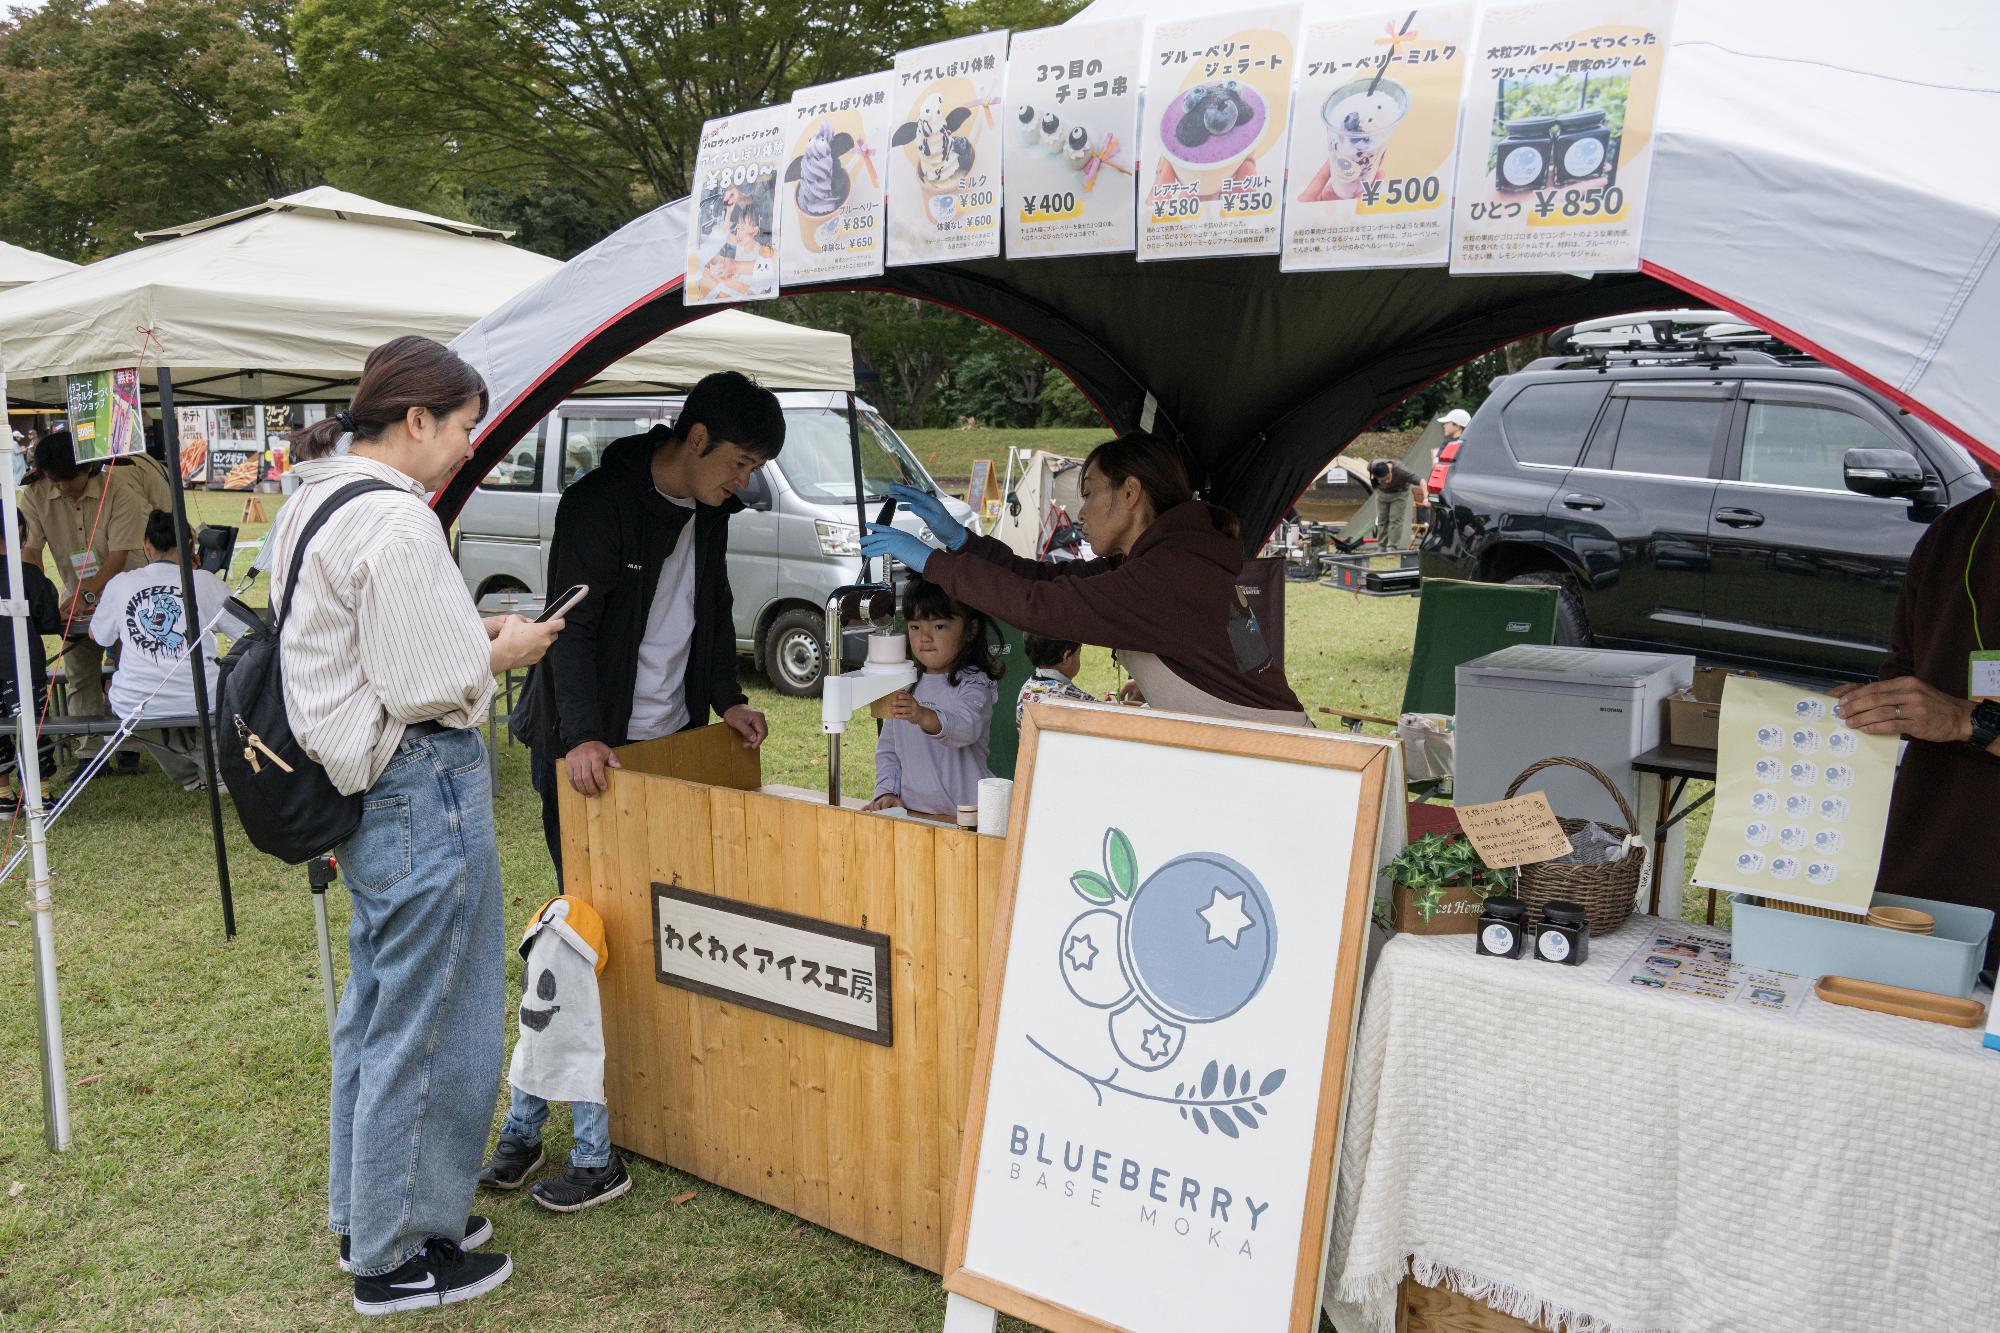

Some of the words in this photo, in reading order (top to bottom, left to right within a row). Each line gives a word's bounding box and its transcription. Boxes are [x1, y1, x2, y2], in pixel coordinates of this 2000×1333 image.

[1160, 41, 1251, 66] ブルーベリー
[1487, 32, 1656, 60] 大粒ブルーベリーでつくった
[901, 55, 996, 87] アイスしぼり体験
[1036, 58, 1103, 83] 3つ目の
[1205, 54, 1283, 79] ジェラート
[1308, 45, 1457, 77] ブルーベリーミルク
[1491, 55, 1647, 80] ブルーベリー農家のジャム
[1055, 75, 1128, 104] チョコ串
[797, 91, 885, 119] アイスしぼり体験
[703, 126, 779, 149] ハロウィンバージョンの
[958, 174, 987, 189] ミルク
[1153, 181, 1200, 196] レアチーズ
[1222, 176, 1272, 191] ヨーグルト
[1361, 176, 1440, 206] ¥500
[839, 202, 879, 216] ブルーベリー
[960, 191, 992, 208] ¥800
[1023, 191, 1075, 215] ¥400
[1154, 197, 1200, 217] ¥580
[1223, 192, 1273, 212] ¥550
[1470, 201, 1522, 220] ひとつ
[1534, 187, 1624, 218] ¥850
[843, 215, 874, 231] ¥850
[937, 221, 962, 231] 体験なし
[966, 214, 992, 227] ¥600
[821, 242, 845, 253] 体験なし
[849, 236, 873, 249] ¥650
[664, 924, 873, 1004] わくわくアイス工房
[1010, 1124, 1269, 1232] BLUEBERRY
[1010, 1162, 1102, 1208] BASE
[1140, 1205, 1253, 1260] MOKA
